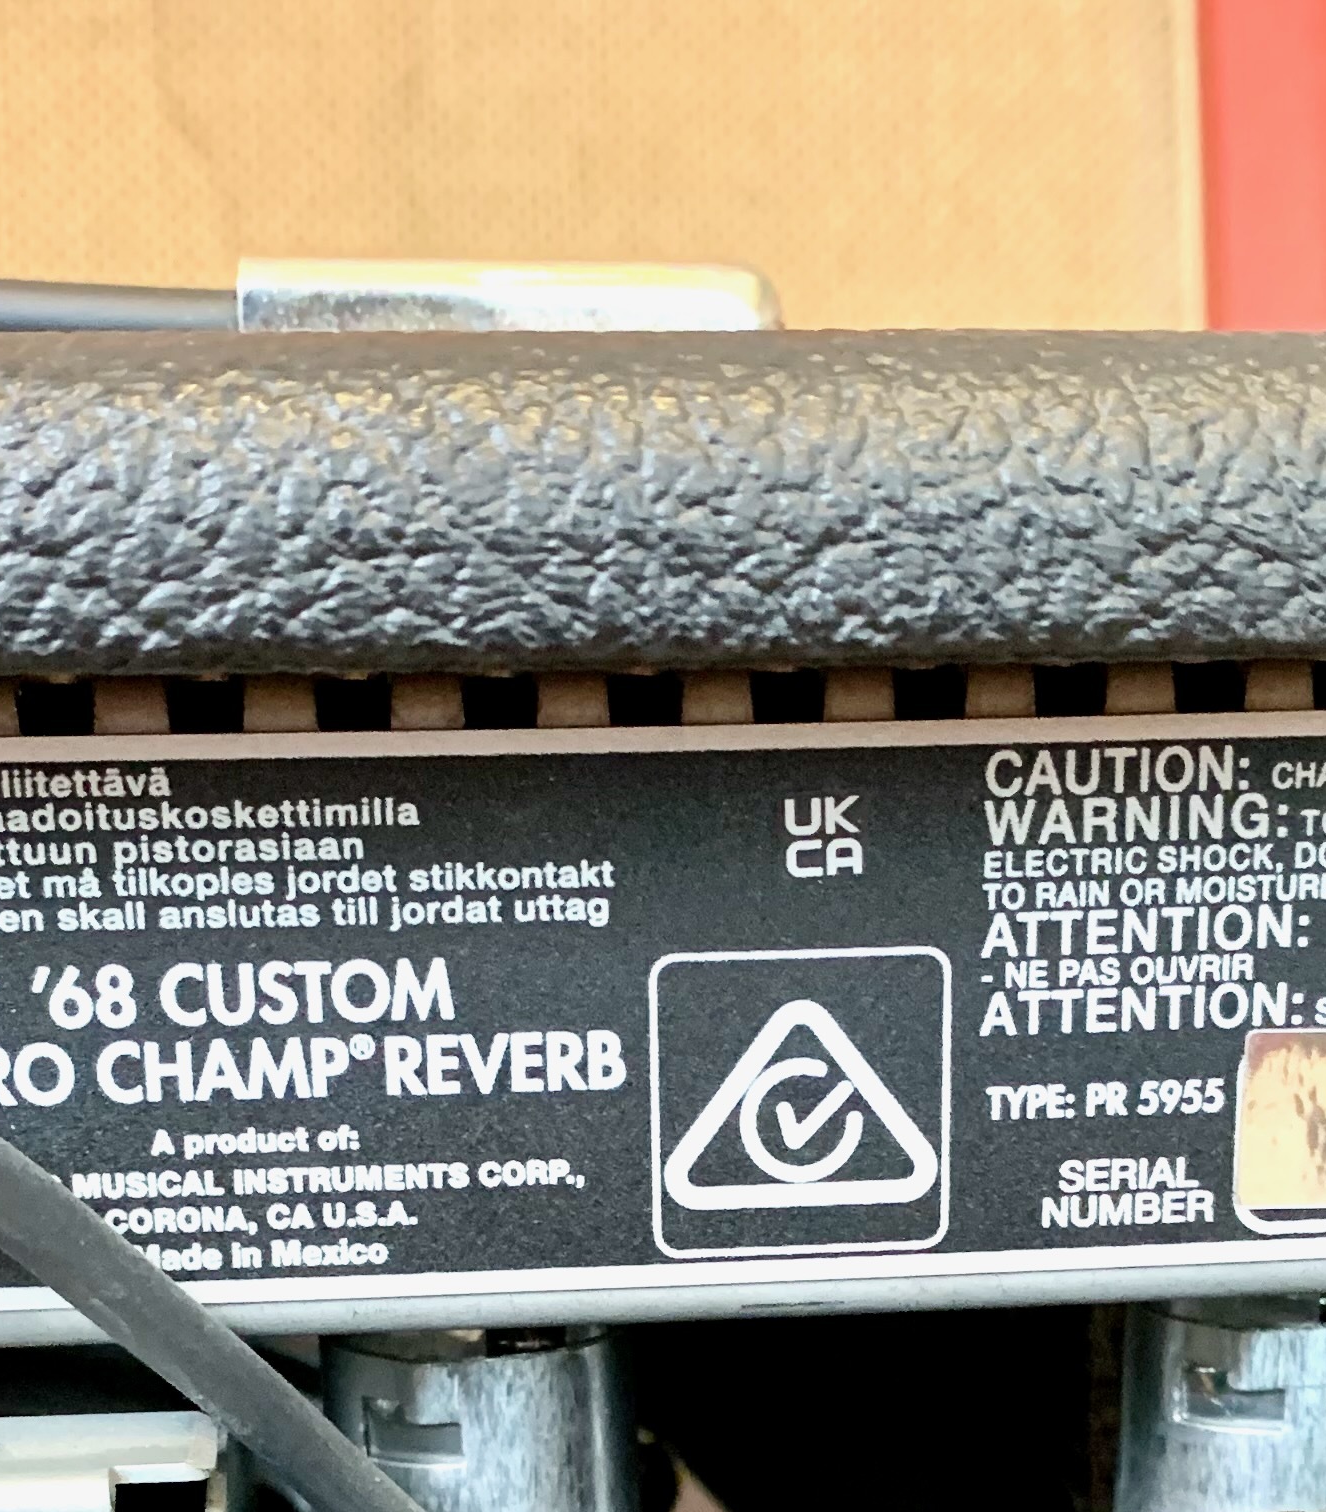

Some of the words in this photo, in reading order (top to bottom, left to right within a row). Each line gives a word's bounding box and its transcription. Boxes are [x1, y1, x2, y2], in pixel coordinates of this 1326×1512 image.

[1, 767, 171, 798] liitettävä
[985, 745, 1249, 797] CAUTION:
[785, 795, 860, 836] UK
[984, 793, 1289, 846] WARNING:
[115, 832, 364, 873] pistorasiaan
[786, 838, 862, 878] CA
[984, 846, 1147, 878] ELECTRIC
[1157, 843, 1283, 874] SHOCK,
[43, 867, 102, 898] må
[114, 867, 276, 901] tilkoples
[286, 864, 397, 901] jordet
[409, 860, 615, 892] stikkontakt
[982, 882, 1025, 910] TO
[1036, 880, 1109, 909] RAIN
[1120, 878, 1166, 907] OR
[58, 901, 145, 931] skall
[159, 899, 320, 929] anslutas
[332, 896, 378, 925] till
[390, 895, 502, 931] jordat
[514, 894, 609, 927] uttag
[979, 905, 1310, 959] ATTENTION:
[1004, 959, 1053, 990] NE
[1059, 957, 1120, 987] PAS
[1130, 953, 1253, 985] OUVRIR
[31, 964, 137, 1030] '68
[159, 957, 455, 1027] CUSTOM
[979, 982, 1304, 1037] ATTENTION:
[384, 1030, 627, 1096] REVERB
[986, 1084, 1075, 1120] TYPE:
[1086, 1081, 1128, 1117] PR
[1136, 1078, 1225, 1115] 5955
[151, 1129, 175, 1156] A
[184, 1127, 309, 1160] product
[317, 1124, 360, 1151] of:
[71, 1169, 224, 1199] MUSICAL
[233, 1162, 470, 1195] INSTRUMENTS
[1059, 1157, 1199, 1193] SERIAL
[103, 1204, 258, 1236] CORONA,
[267, 1203, 315, 1230] CA
[323, 1201, 418, 1228] U.S.A.
[1042, 1189, 1214, 1228] NUMBER
[231, 1242, 262, 1268] in
[270, 1238, 389, 1267] Mexico
